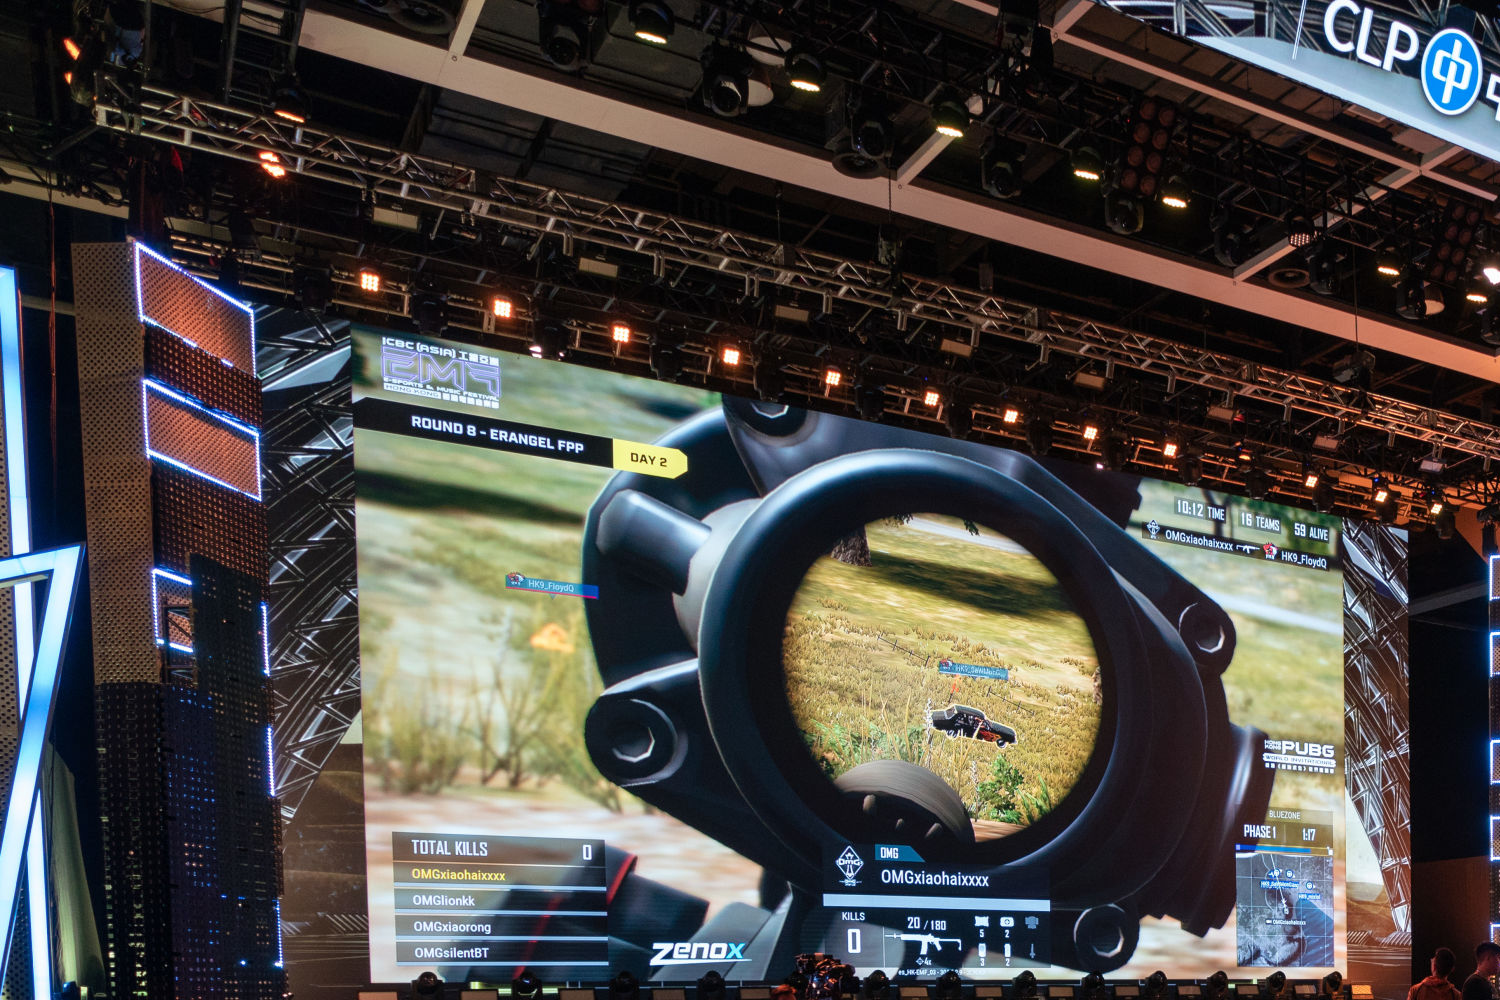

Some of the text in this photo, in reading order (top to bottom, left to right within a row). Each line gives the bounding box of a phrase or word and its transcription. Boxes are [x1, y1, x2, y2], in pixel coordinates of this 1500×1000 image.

[1324, 0, 1419, 71] CLP
[382, 336, 414, 350] ICBC
[416, 342, 456, 358] (ASIA)
[411, 415, 463, 435] ROUND
[467, 424, 477, 437] 8
[490, 428, 555, 450] ERANGEL
[558, 440, 584, 453] FPP
[631, 452, 667, 467] DAY 2
[1177, 499, 1329, 541] 10:12 TIME 16 TEAMS 59 ALIVE
[1281, 740, 1335, 758] PUBG
[1269, 810, 1301, 819] BLUEZONE
[1243, 824, 1271, 838] PHASE
[1302, 828, 1316, 841] 1:17
[412, 839, 592, 861] TOTAL KILLS 0
[880, 847, 899, 859] OMG
[411, 868, 506, 881] OMGxiaohaixxxx
[881, 869, 989, 887] OMGxiaohaixxxx
[413, 895, 475, 907] OMGlionkk
[841, 912, 865, 921] KILLS
[414, 921, 492, 935] OMGxiaorong
[907, 917, 920, 929] 20
[931, 920, 946, 931] 180
[847, 928, 861, 953] 0
[979, 930, 1010, 938] 5 2
[415, 946, 489, 959] OMGsilentBT
[980, 958, 1010, 966] 3 2
